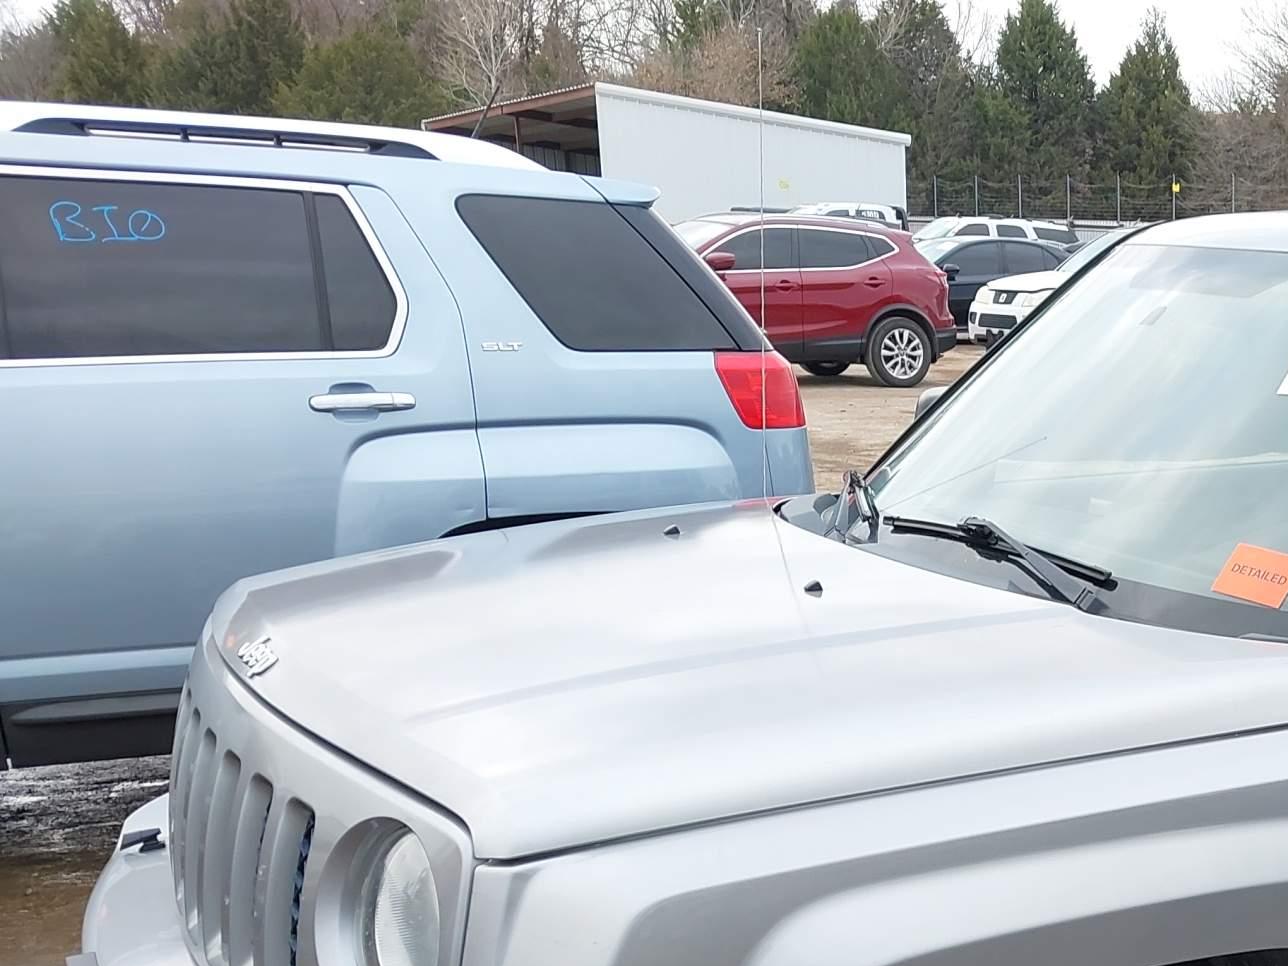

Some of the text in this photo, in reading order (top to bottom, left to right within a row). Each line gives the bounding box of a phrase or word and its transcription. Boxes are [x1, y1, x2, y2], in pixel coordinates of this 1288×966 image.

[480, 341, 523, 353] SLT
[1231, 562, 1288, 585] DETAILED
[237, 636, 279, 678] Jeep
